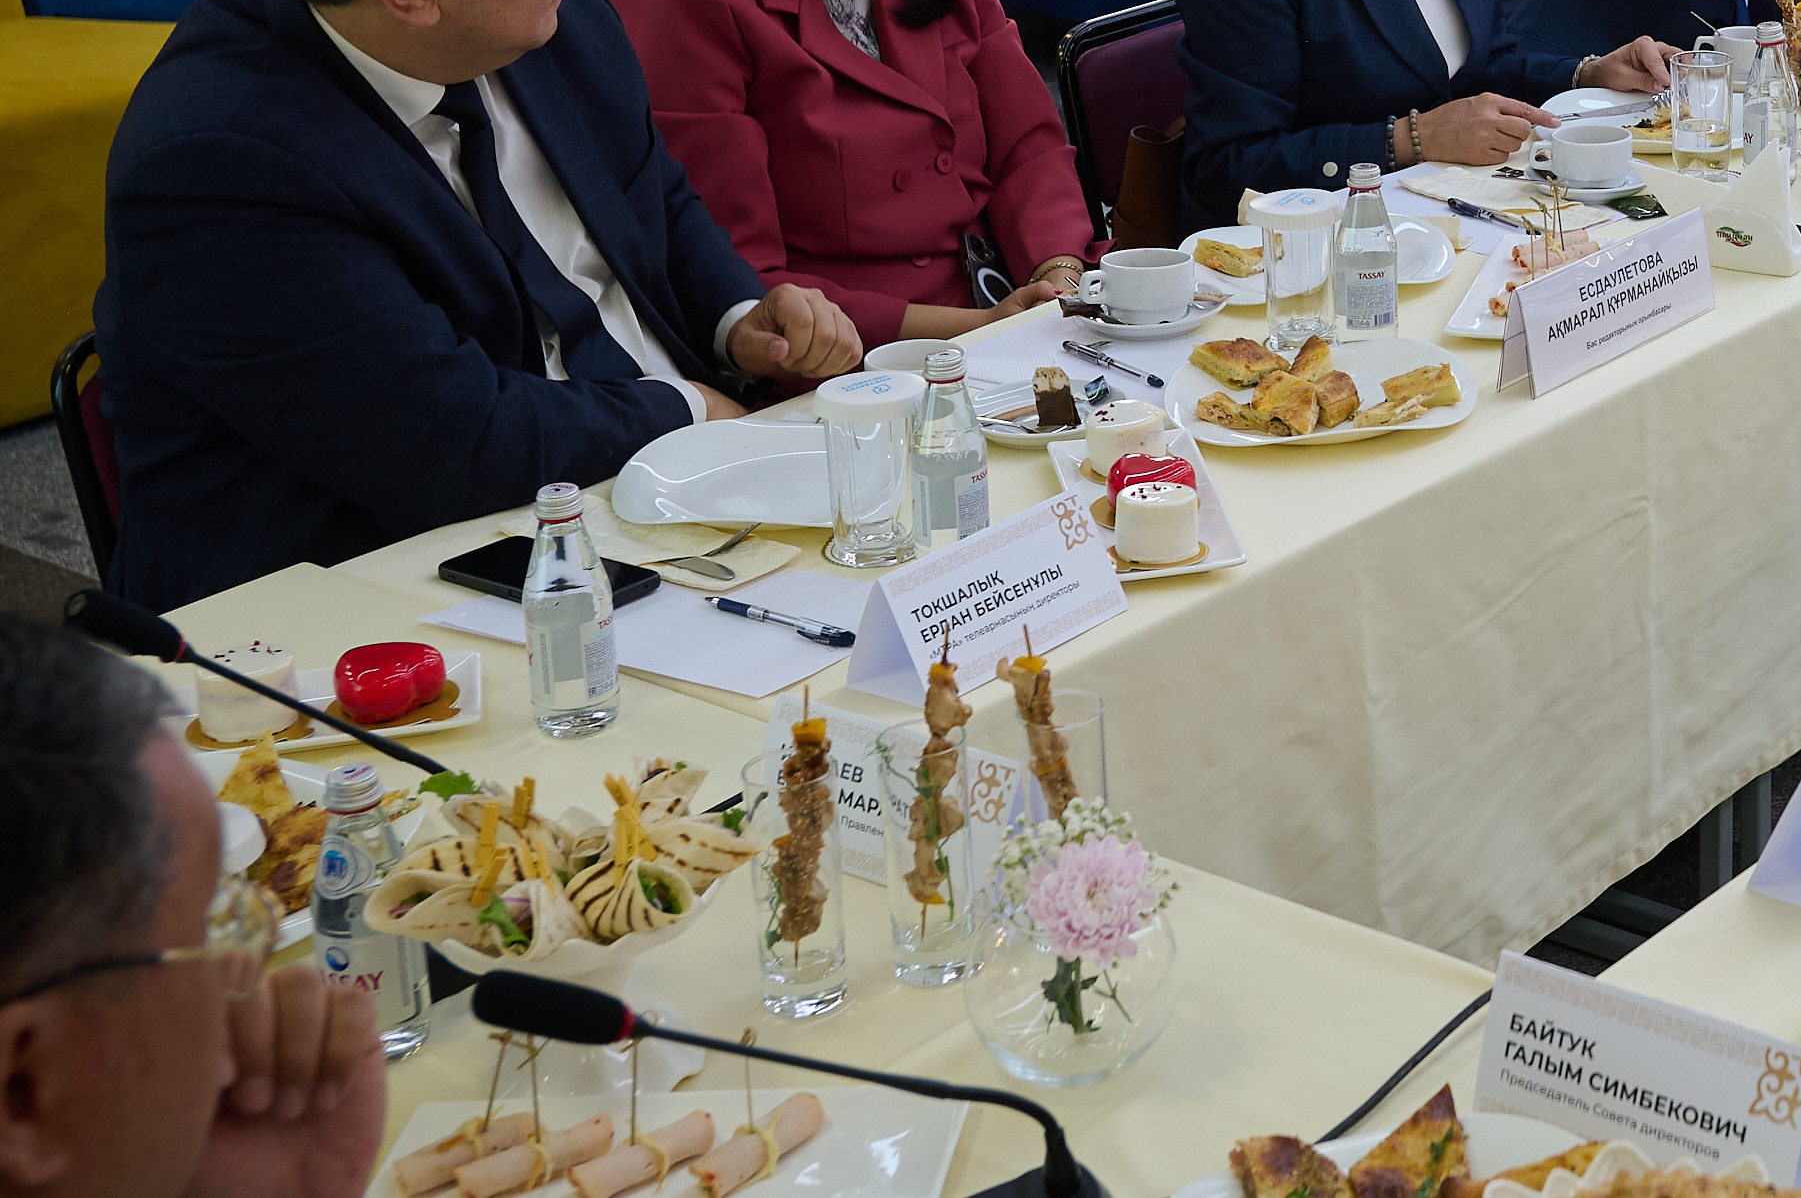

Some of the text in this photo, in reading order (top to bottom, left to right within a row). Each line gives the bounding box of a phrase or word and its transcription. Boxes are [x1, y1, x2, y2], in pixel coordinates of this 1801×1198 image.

[1358, 271, 1385, 280] TASSAY
[1548, 255, 1699, 342] АҚМАРАЛ ҚҰРМАНАЙҚЫЗЫ
[1579, 251, 1663, 302] ЕСДАУЛЕТОВА
[1586, 340, 1598, 350] Бас
[1637, 303, 1672, 329] орынбасары
[911, 570, 1005, 624] ТОКШАЛЫҚ
[919, 564, 1064, 644] ЕРЛАН БЕЙСЕНҰЛЫ
[963, 604, 1036, 644] телеарнасының
[1035, 580, 1081, 615] директоры
[1509, 1012, 1597, 1060] БАЙТУК
[1499, 1068, 1720, 1162] Председатель Совета директоров
[1504, 1040, 1748, 1144] ГАЛЫМ СИМБЕКОВИЧ
